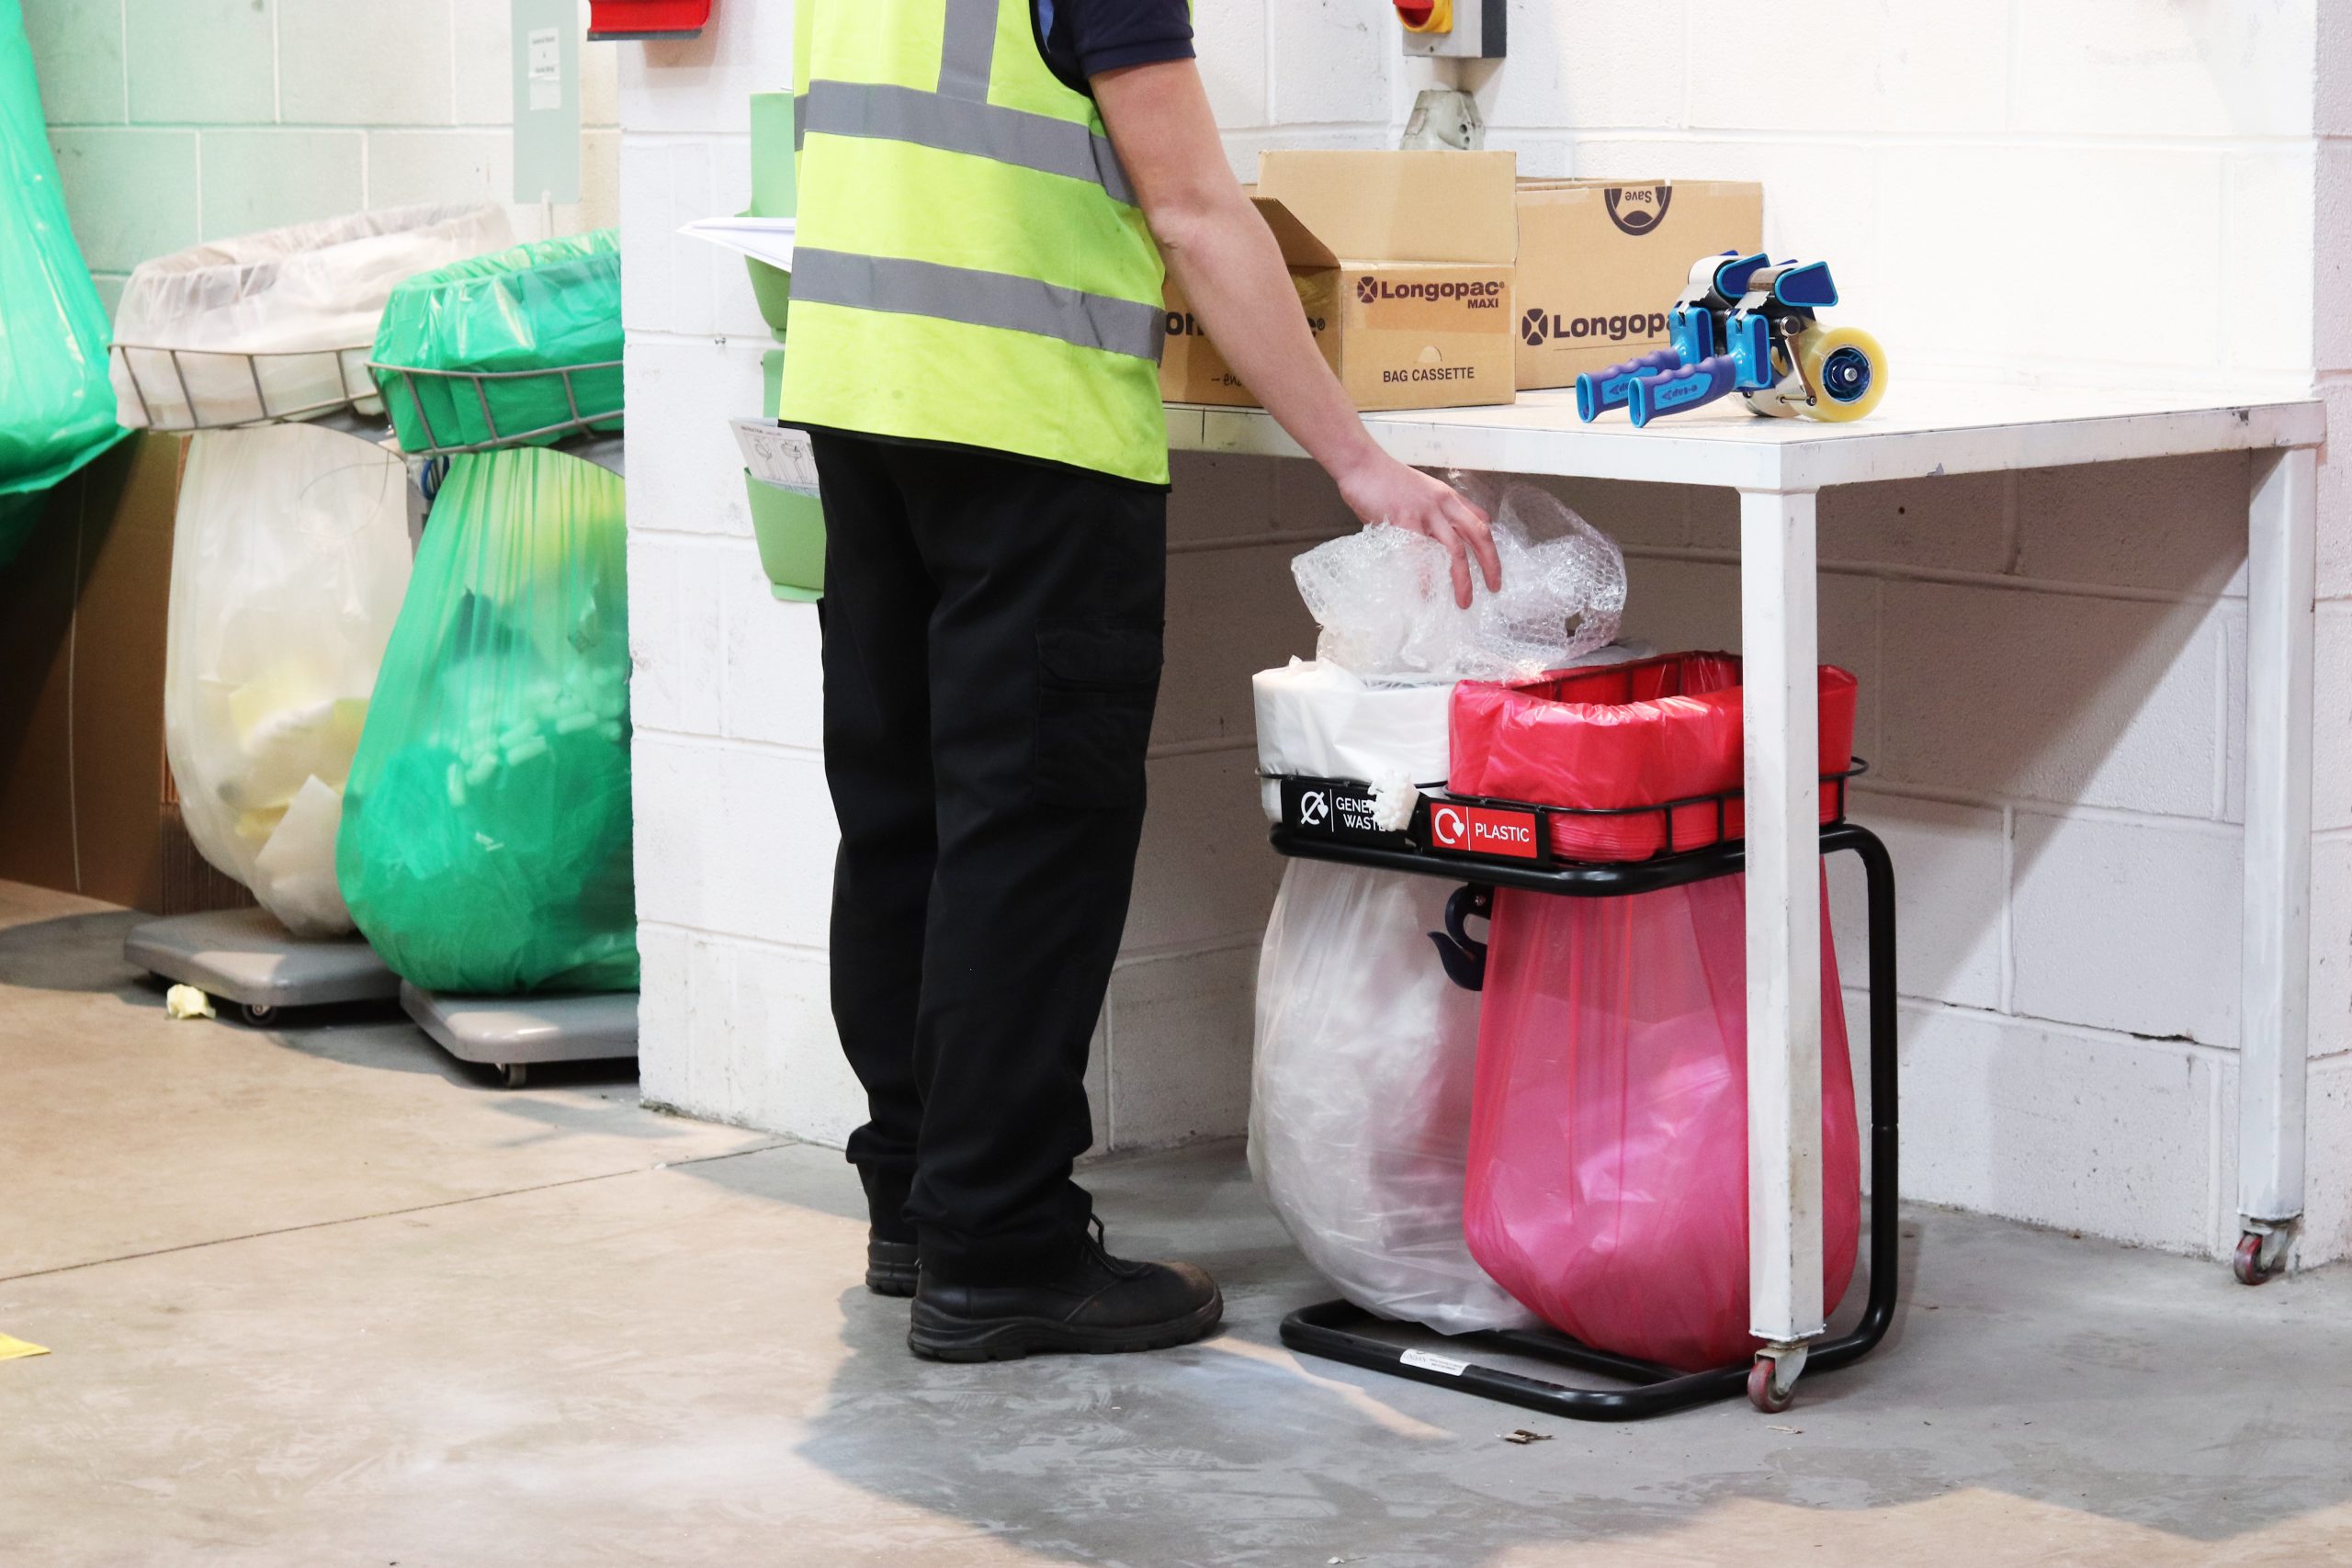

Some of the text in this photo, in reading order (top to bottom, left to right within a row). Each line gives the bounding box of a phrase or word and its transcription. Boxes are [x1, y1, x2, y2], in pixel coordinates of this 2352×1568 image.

[1624, 190, 1652, 203] Save
[1467, 299, 1499, 310] MAXI
[1554, 310, 1671, 341] Longop
[1383, 367, 1475, 383] BAG CASSETTE
[1335, 796, 1374, 814] GENE
[1475, 822, 1530, 843] PLASTIC
